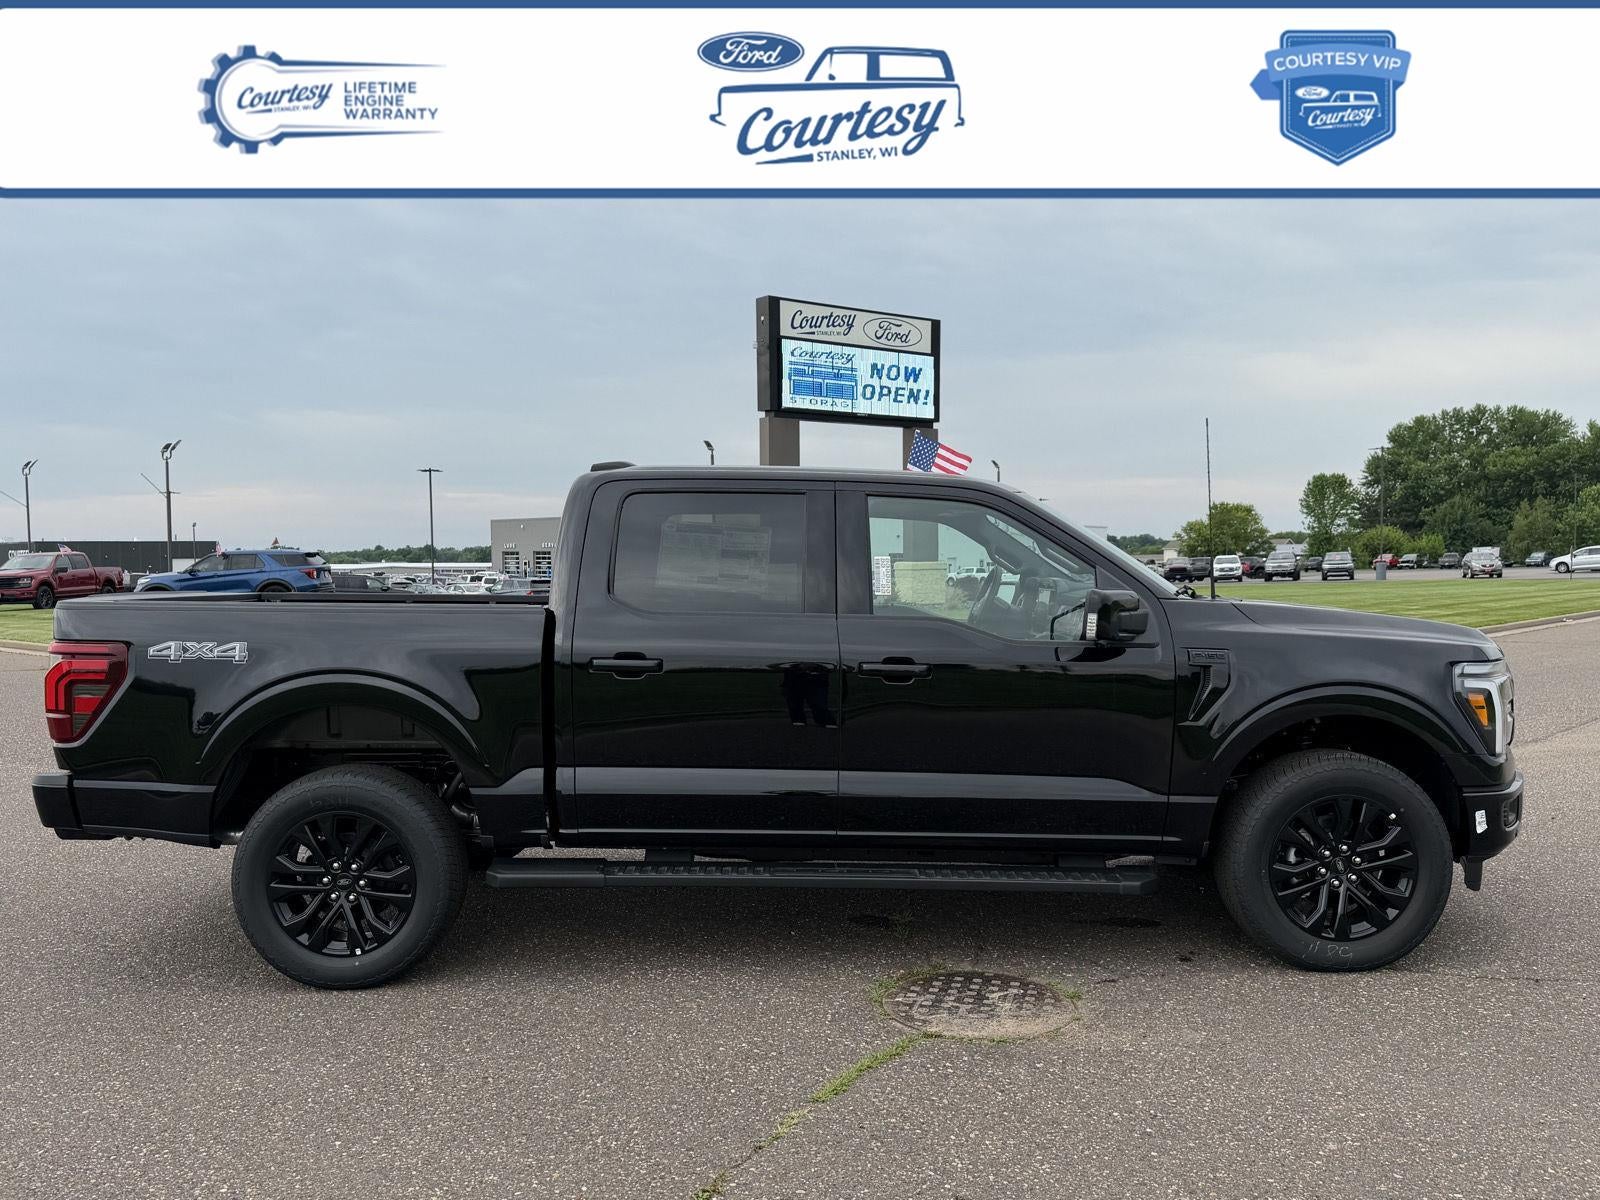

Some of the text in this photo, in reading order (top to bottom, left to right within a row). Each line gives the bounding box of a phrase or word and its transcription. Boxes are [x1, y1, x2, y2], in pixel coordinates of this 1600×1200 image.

[790, 309, 912, 344] Courtesy Ford
[790, 346, 857, 366] Courtesy
[869, 361, 923, 384] NOW
[861, 383, 930, 406] OPEN!
